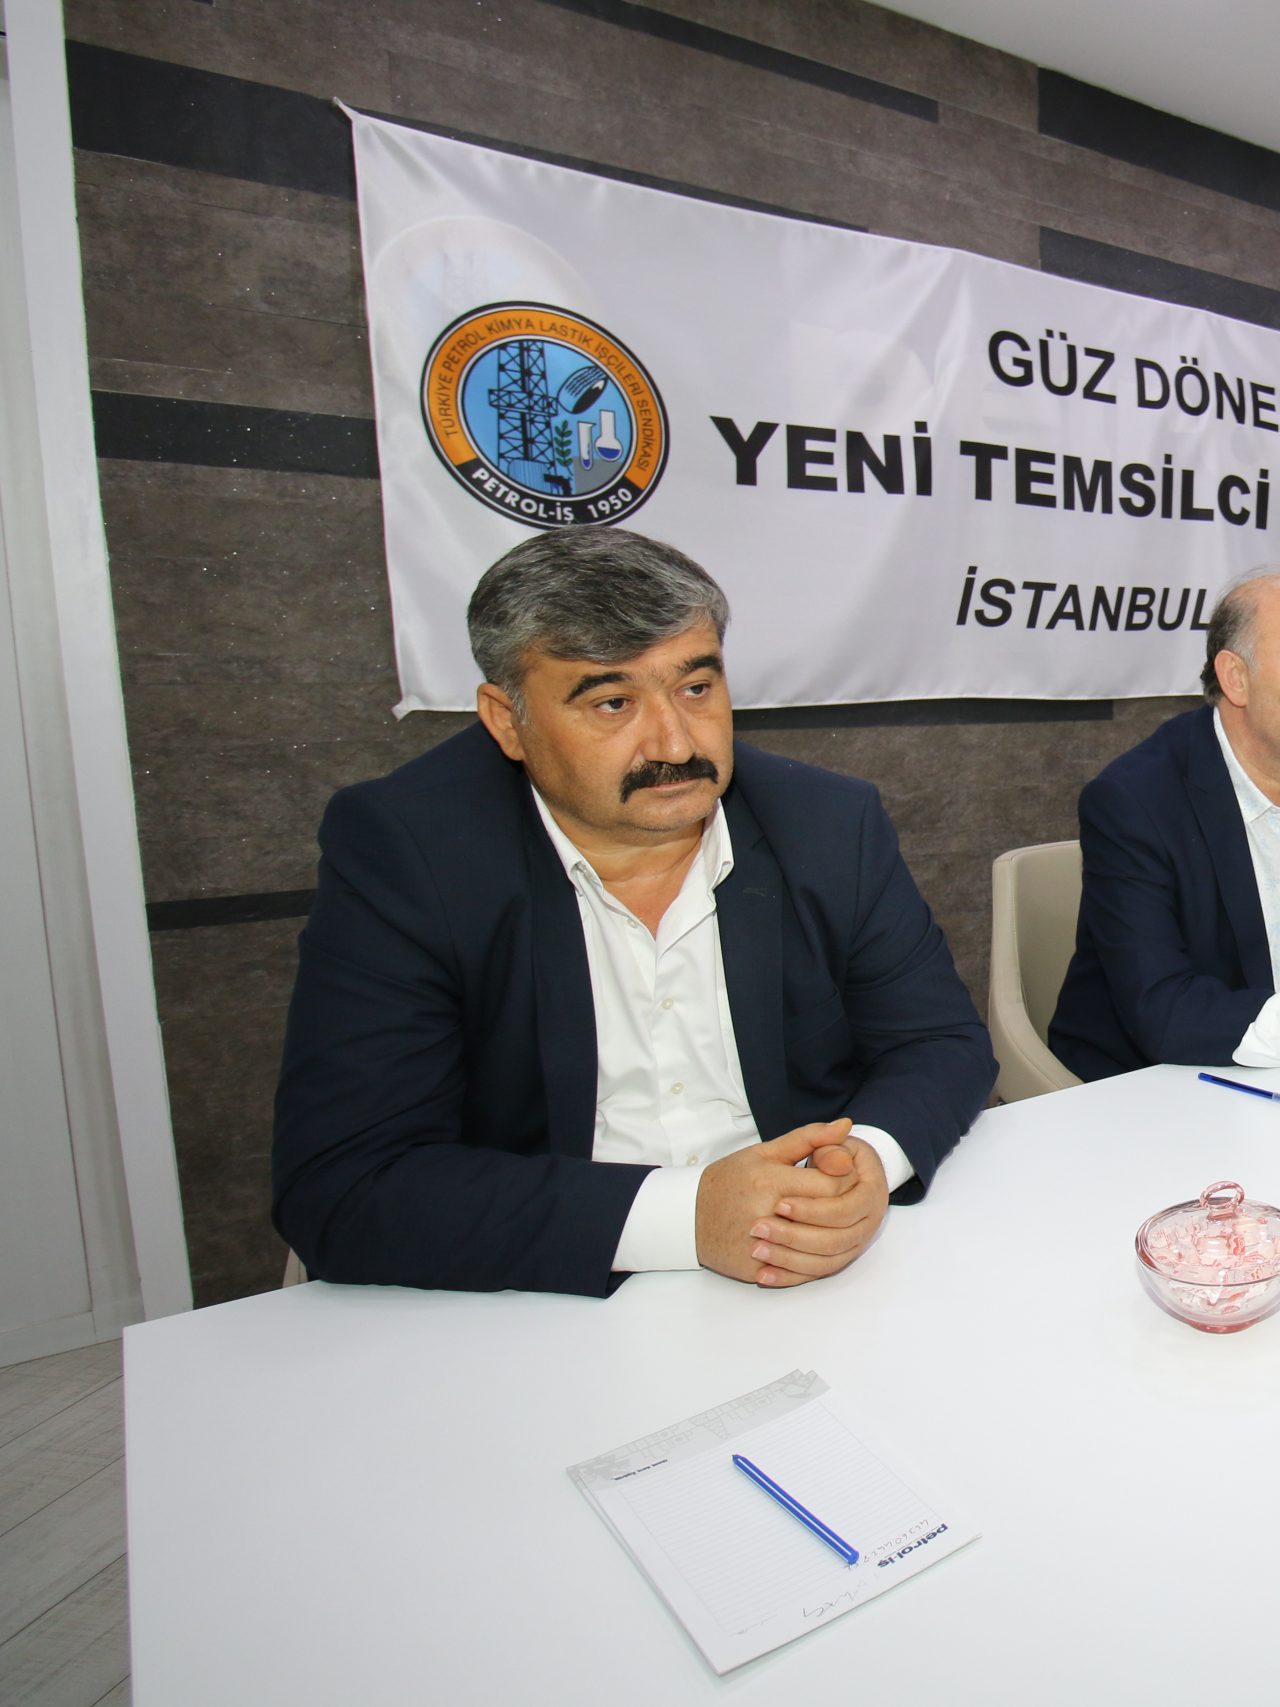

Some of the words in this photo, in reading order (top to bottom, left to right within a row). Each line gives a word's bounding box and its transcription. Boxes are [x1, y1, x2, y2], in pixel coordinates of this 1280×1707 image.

[445, 329, 486, 373] PETROL
[485, 317, 535, 337] KİMYA
[539, 320, 592, 346] LASTİK
[634, 397, 656, 472] SENDİKASI
[989, 330, 1117, 404] GÜZ
[472, 467, 575, 524] PETROL-İŞ
[586, 488, 633, 519] 1950
[711, 416, 933, 497] YENİ
[960, 441, 1270, 531] TEMSİLCİ
[956, 565, 1211, 631] İSTANBUL
